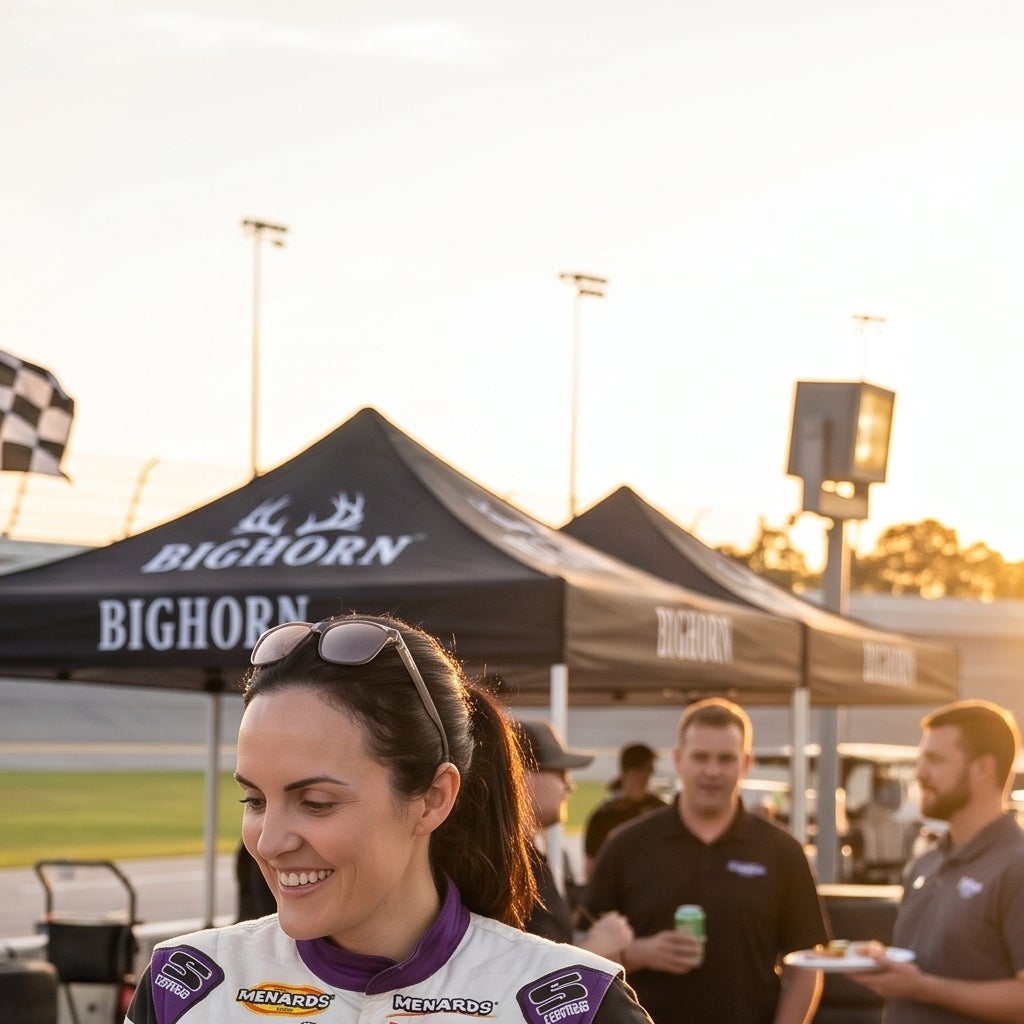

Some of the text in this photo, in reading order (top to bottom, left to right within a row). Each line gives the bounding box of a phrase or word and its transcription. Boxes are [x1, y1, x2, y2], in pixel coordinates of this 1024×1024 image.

[140, 534, 415, 574] BIGHORN
[236, 988, 331, 1010] MENARDS
[392, 994, 494, 1016] MENARDS
